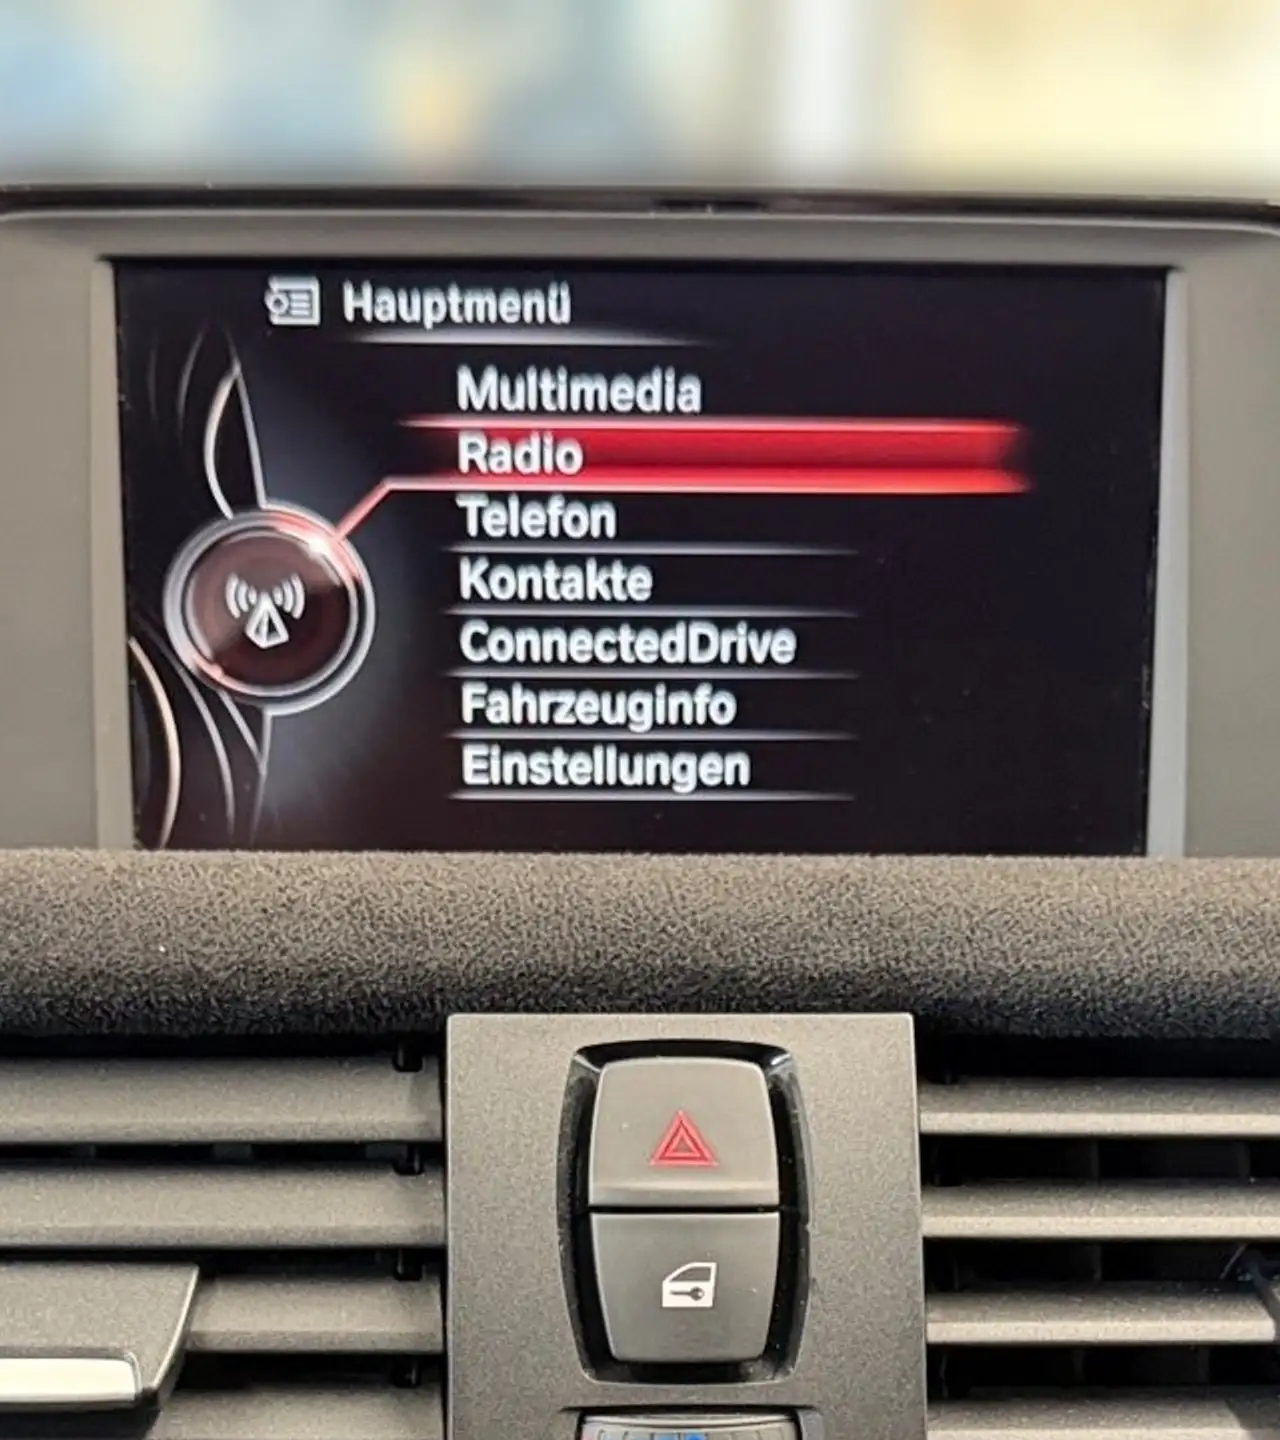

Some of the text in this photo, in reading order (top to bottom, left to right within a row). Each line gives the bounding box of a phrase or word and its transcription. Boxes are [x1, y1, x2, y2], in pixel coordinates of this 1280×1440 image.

[342, 281, 572, 329] Hauptmenü
[456, 366, 703, 415] Multimedia
[457, 432, 584, 475] Radio
[457, 497, 616, 540] Telefon
[458, 560, 654, 603] Kontakte
[459, 621, 798, 666] ConnectedDrive
[461, 685, 737, 734] Fahrzeuginfo
[462, 746, 752, 796] Einstellungen
